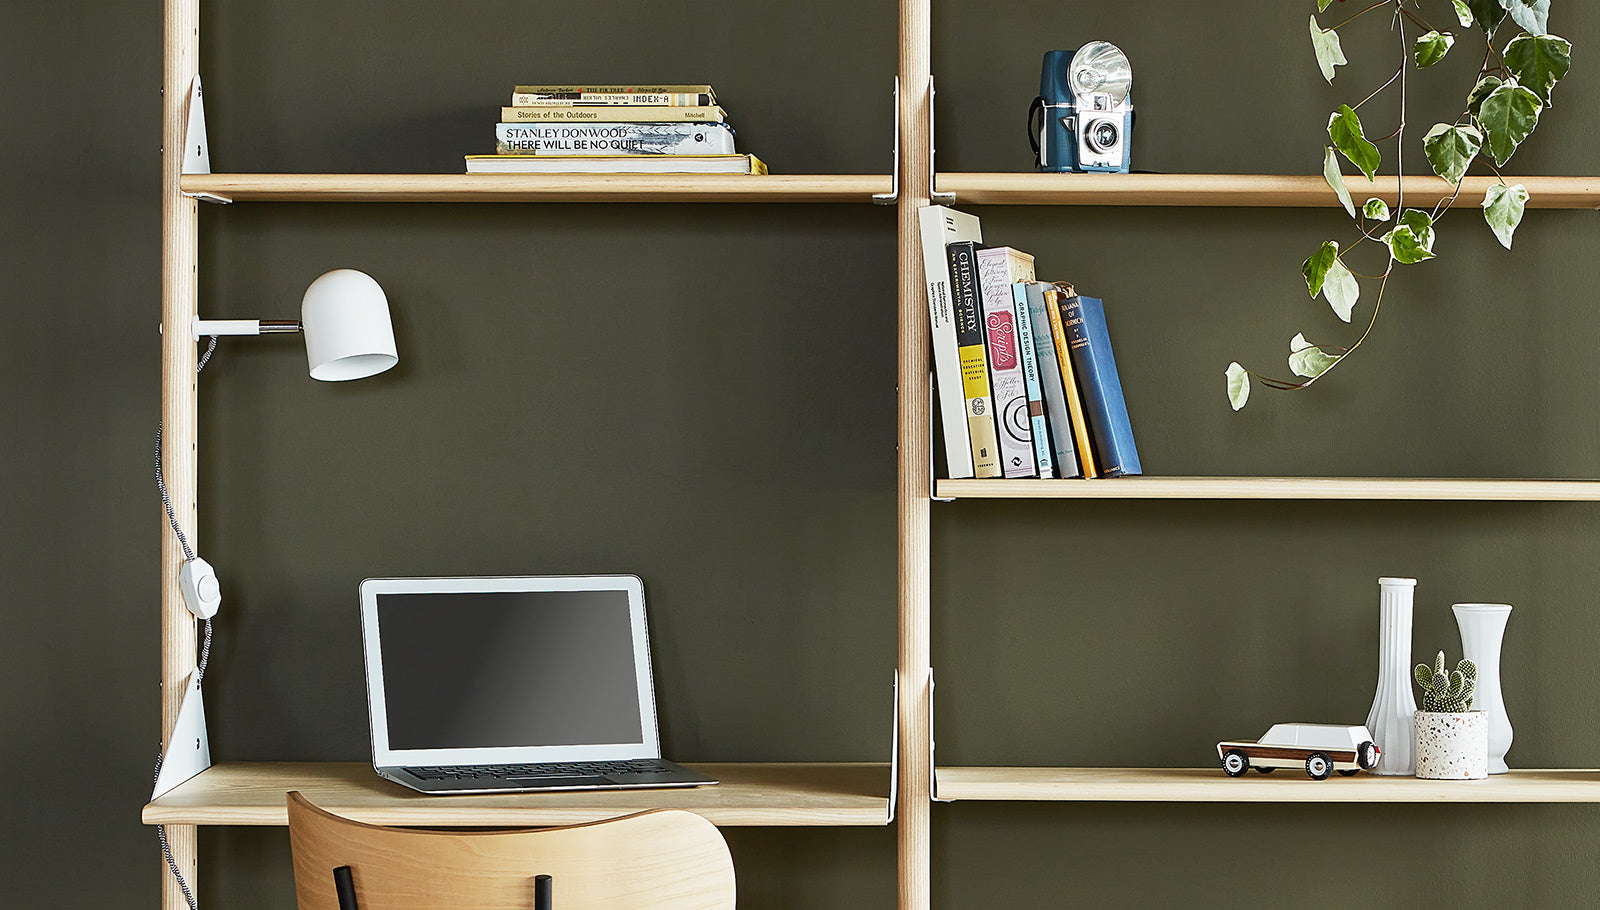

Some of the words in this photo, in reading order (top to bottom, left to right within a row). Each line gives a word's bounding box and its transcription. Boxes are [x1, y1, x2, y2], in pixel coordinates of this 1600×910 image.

[506, 129, 560, 138] STANLEY
[562, 128, 627, 138] DONWOOD
[507, 140, 541, 149] THERE
[544, 140, 571, 149] WILL
[574, 140, 587, 149] BE
[590, 140, 608, 149] NO
[611, 140, 645, 150] QUIET
[959, 252, 976, 332] CHEMISTRY
[1019, 302, 1027, 330] GRAPHIC
[987, 314, 1014, 366] Scripts
[1023, 332, 1031, 355] DESIGN
[1026, 357, 1035, 381] THEORY
